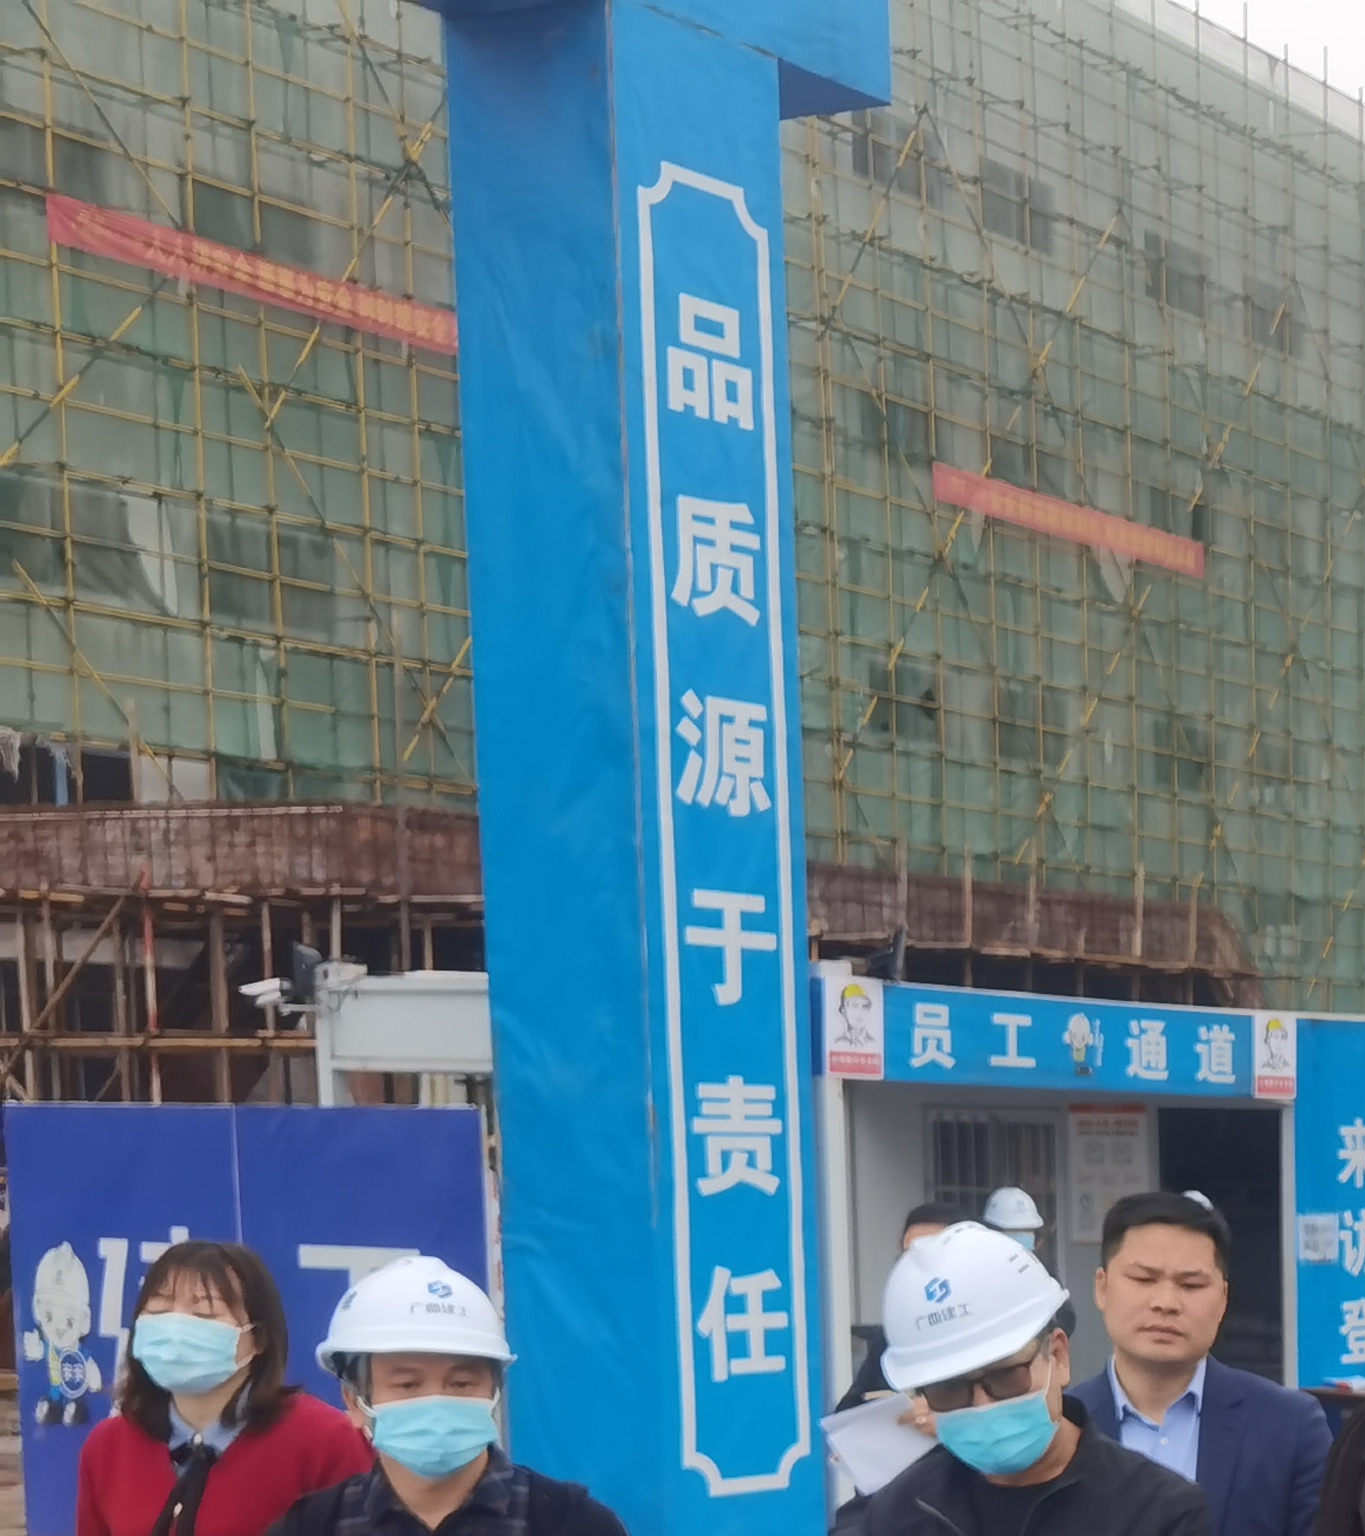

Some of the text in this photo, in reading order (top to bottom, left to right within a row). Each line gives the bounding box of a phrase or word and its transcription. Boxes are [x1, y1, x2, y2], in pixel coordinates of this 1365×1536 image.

[667, 291, 788, 1382] 品质源于责任
[910, 1004, 1236, 1083] 员工通道
